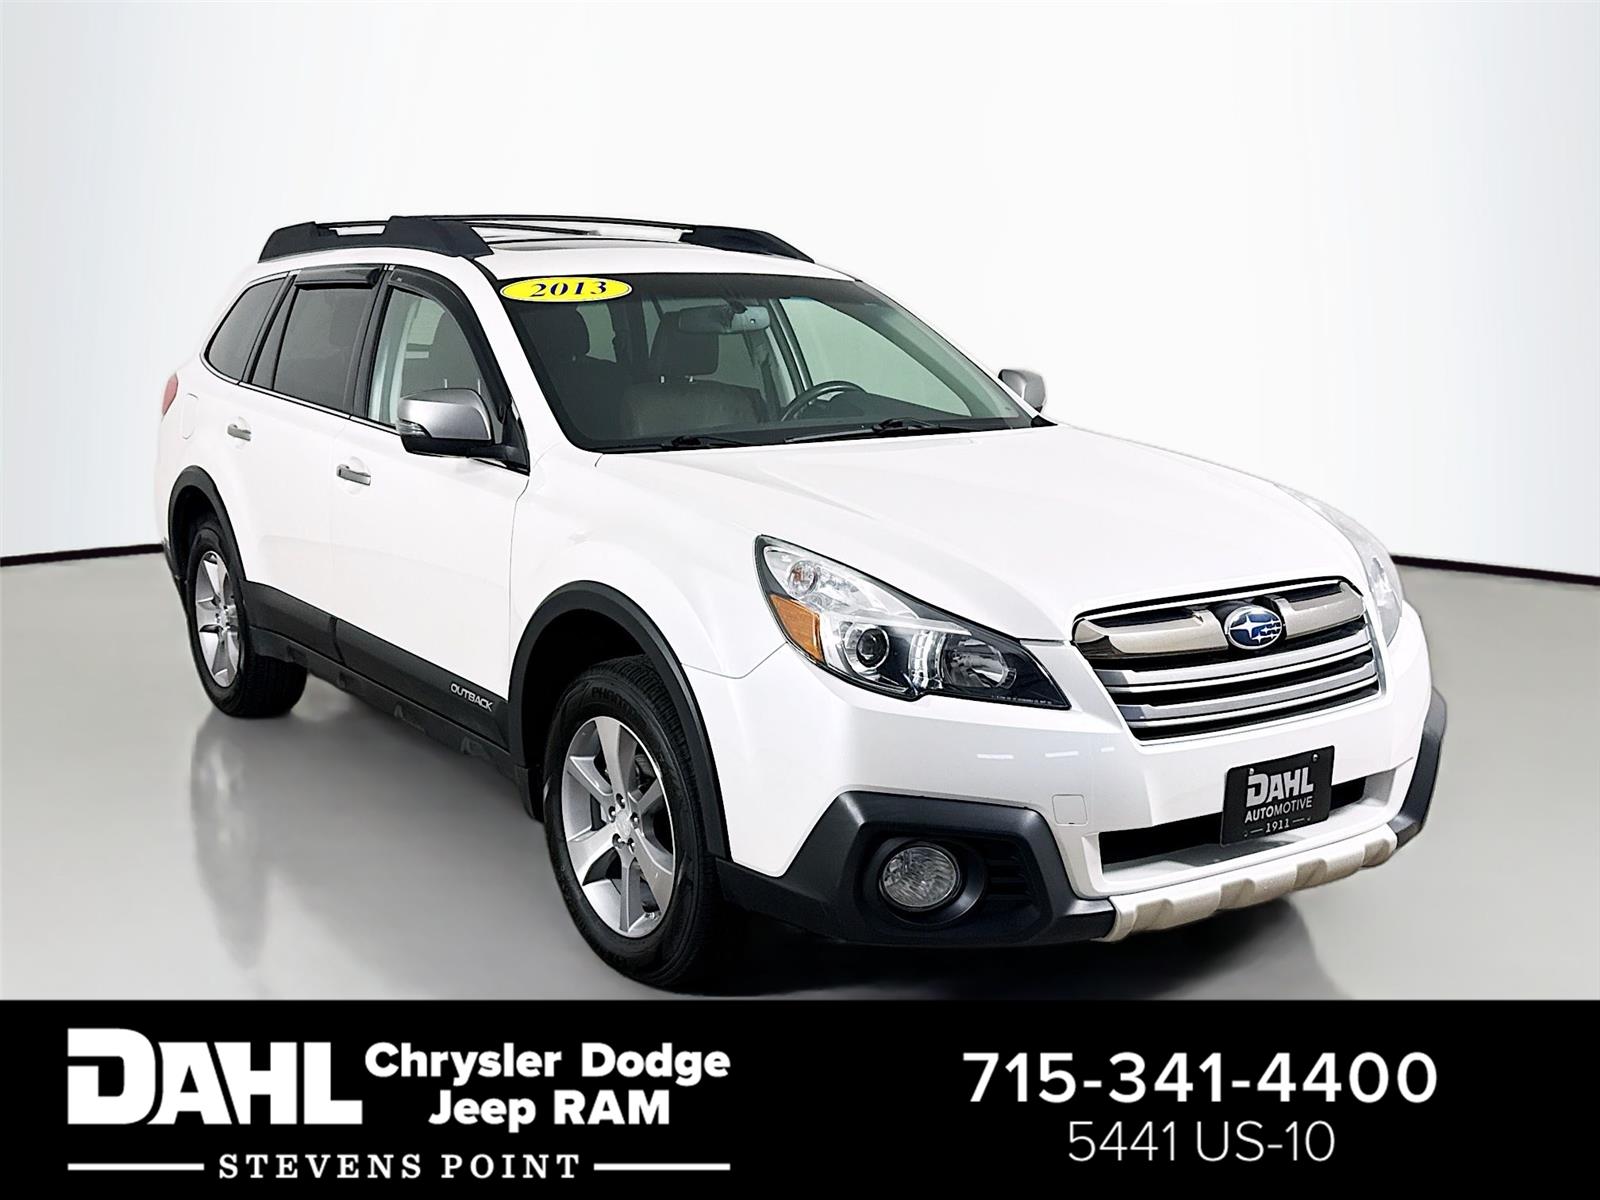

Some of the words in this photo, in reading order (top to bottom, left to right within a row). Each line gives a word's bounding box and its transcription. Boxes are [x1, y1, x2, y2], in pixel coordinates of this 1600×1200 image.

[530, 281, 606, 297] 2013
[450, 683, 493, 712] OUTBACK
[1246, 767, 1314, 808] DAHL
[1244, 796, 1313, 824] AUTOMOTIVE
[1265, 818, 1290, 833] 1911
